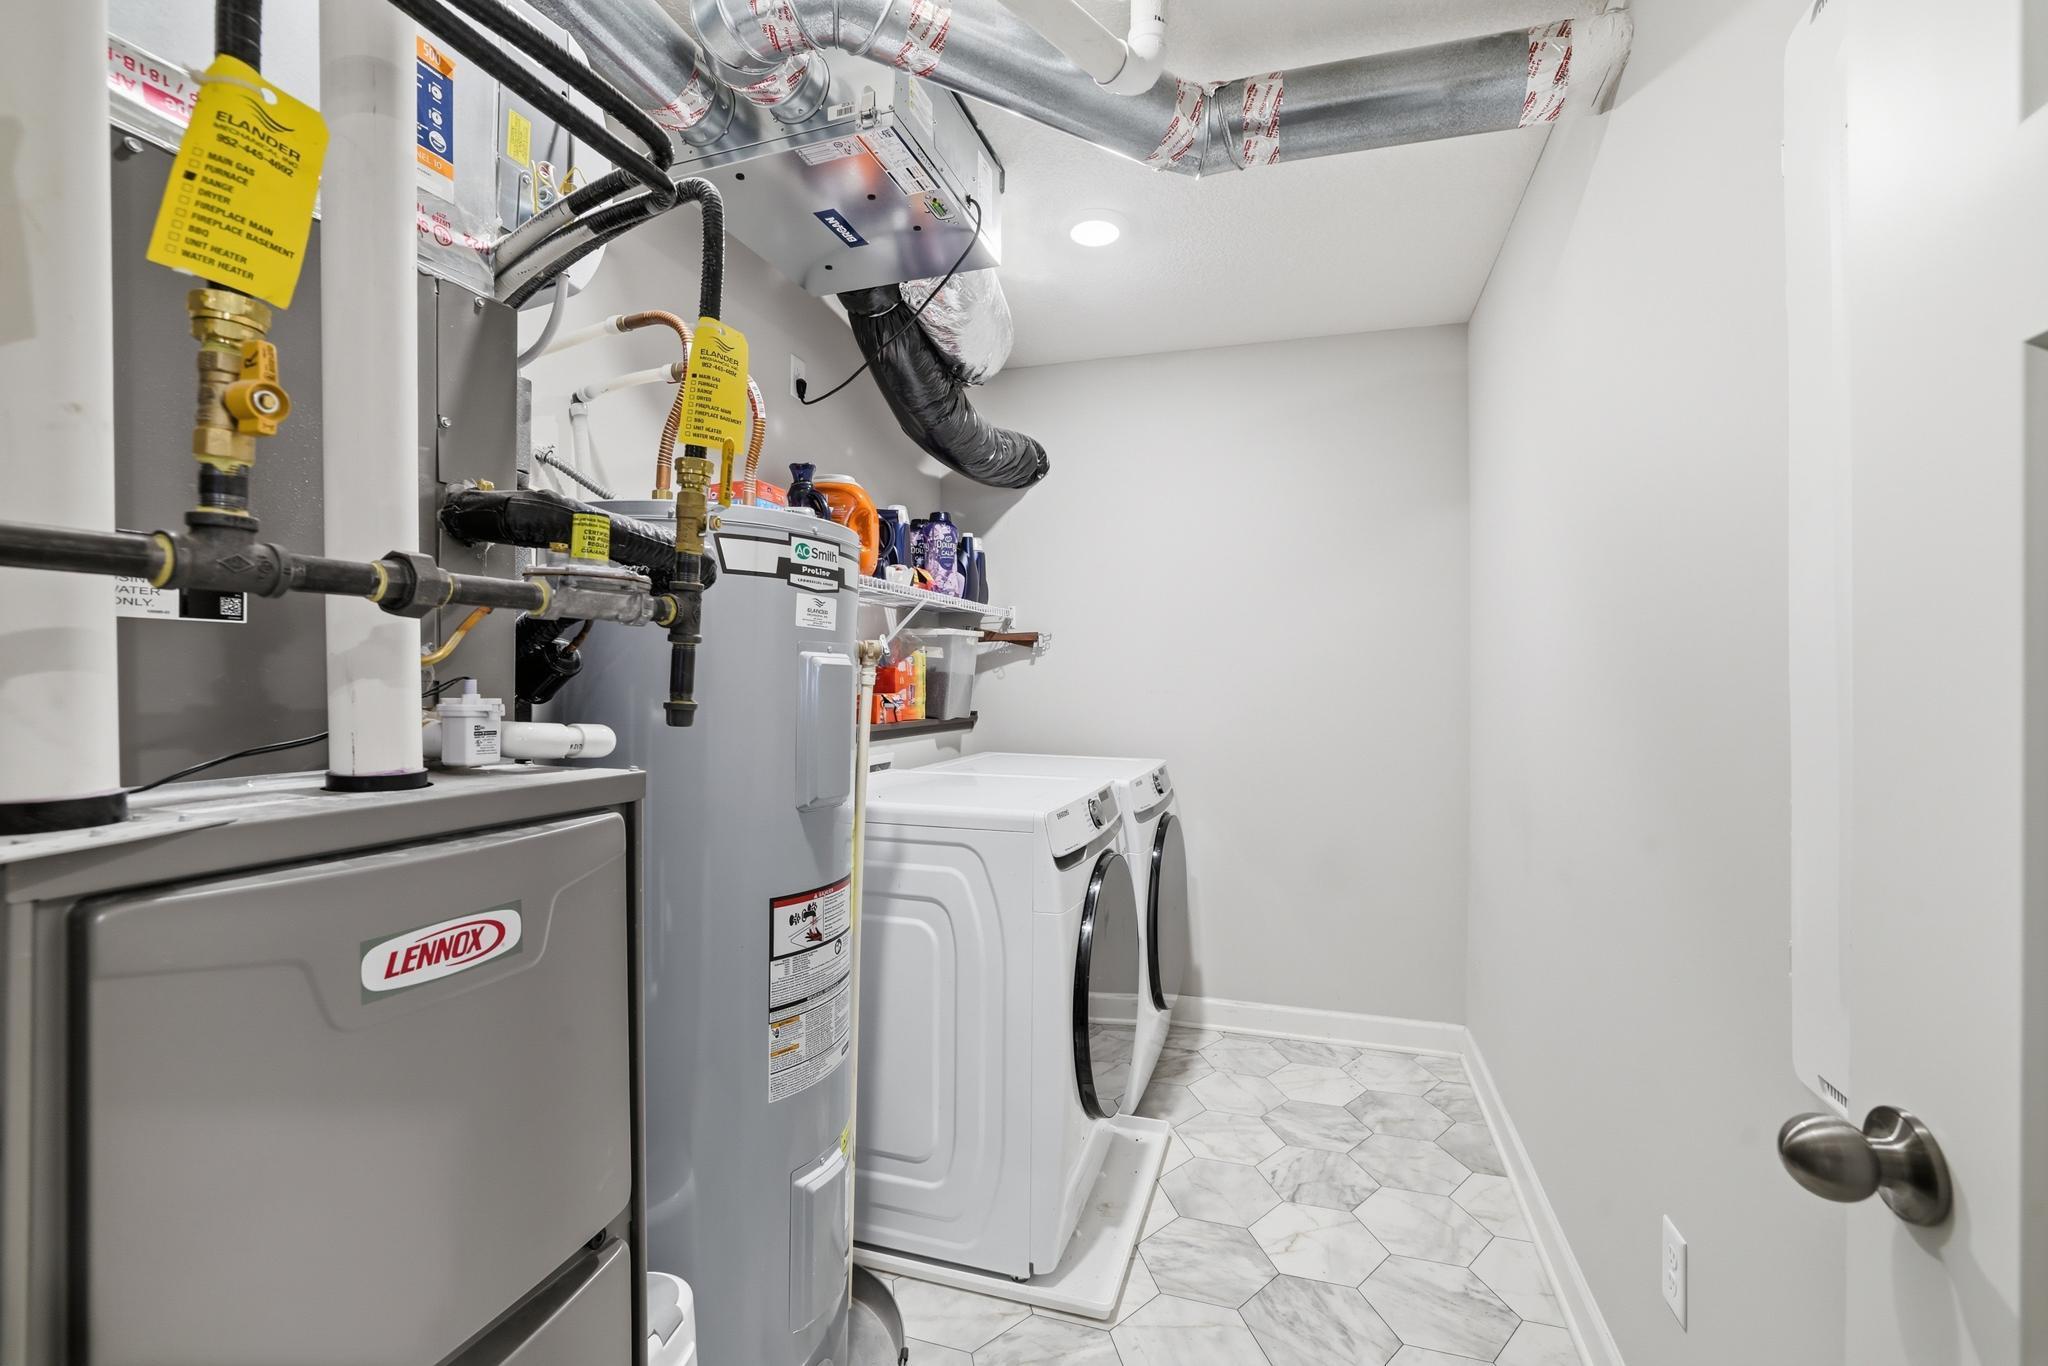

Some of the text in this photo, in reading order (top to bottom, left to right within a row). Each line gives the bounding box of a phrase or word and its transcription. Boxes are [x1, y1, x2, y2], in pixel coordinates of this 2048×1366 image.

[215, 110, 301, 162] ELANDER
[207, 152, 256, 177] MAIN GAS
[216, 133, 294, 178] 952-445-4692
[201, 175, 235, 193] RANGE
[204, 163, 249, 186] FURNACE
[198, 187, 231, 205] DRYER
[194, 199, 274, 237] FIREPLACE MAIN
[187, 224, 209, 238] BBQ
[191, 211, 295, 259] FIREPLACE BASEMENT
[184, 236, 248, 265] UNIT HEATER
[181, 249, 255, 281] WATER HEATER
[700, 348, 740, 367] ELANDER
[694, 410, 719, 420] FIREPLACE
[695, 402, 720, 413] FIREPLACE
[796, 544, 837, 564] AO Smith
[802, 566, 831, 577] ProLine
[384, 925, 486, 980] LENNOX
